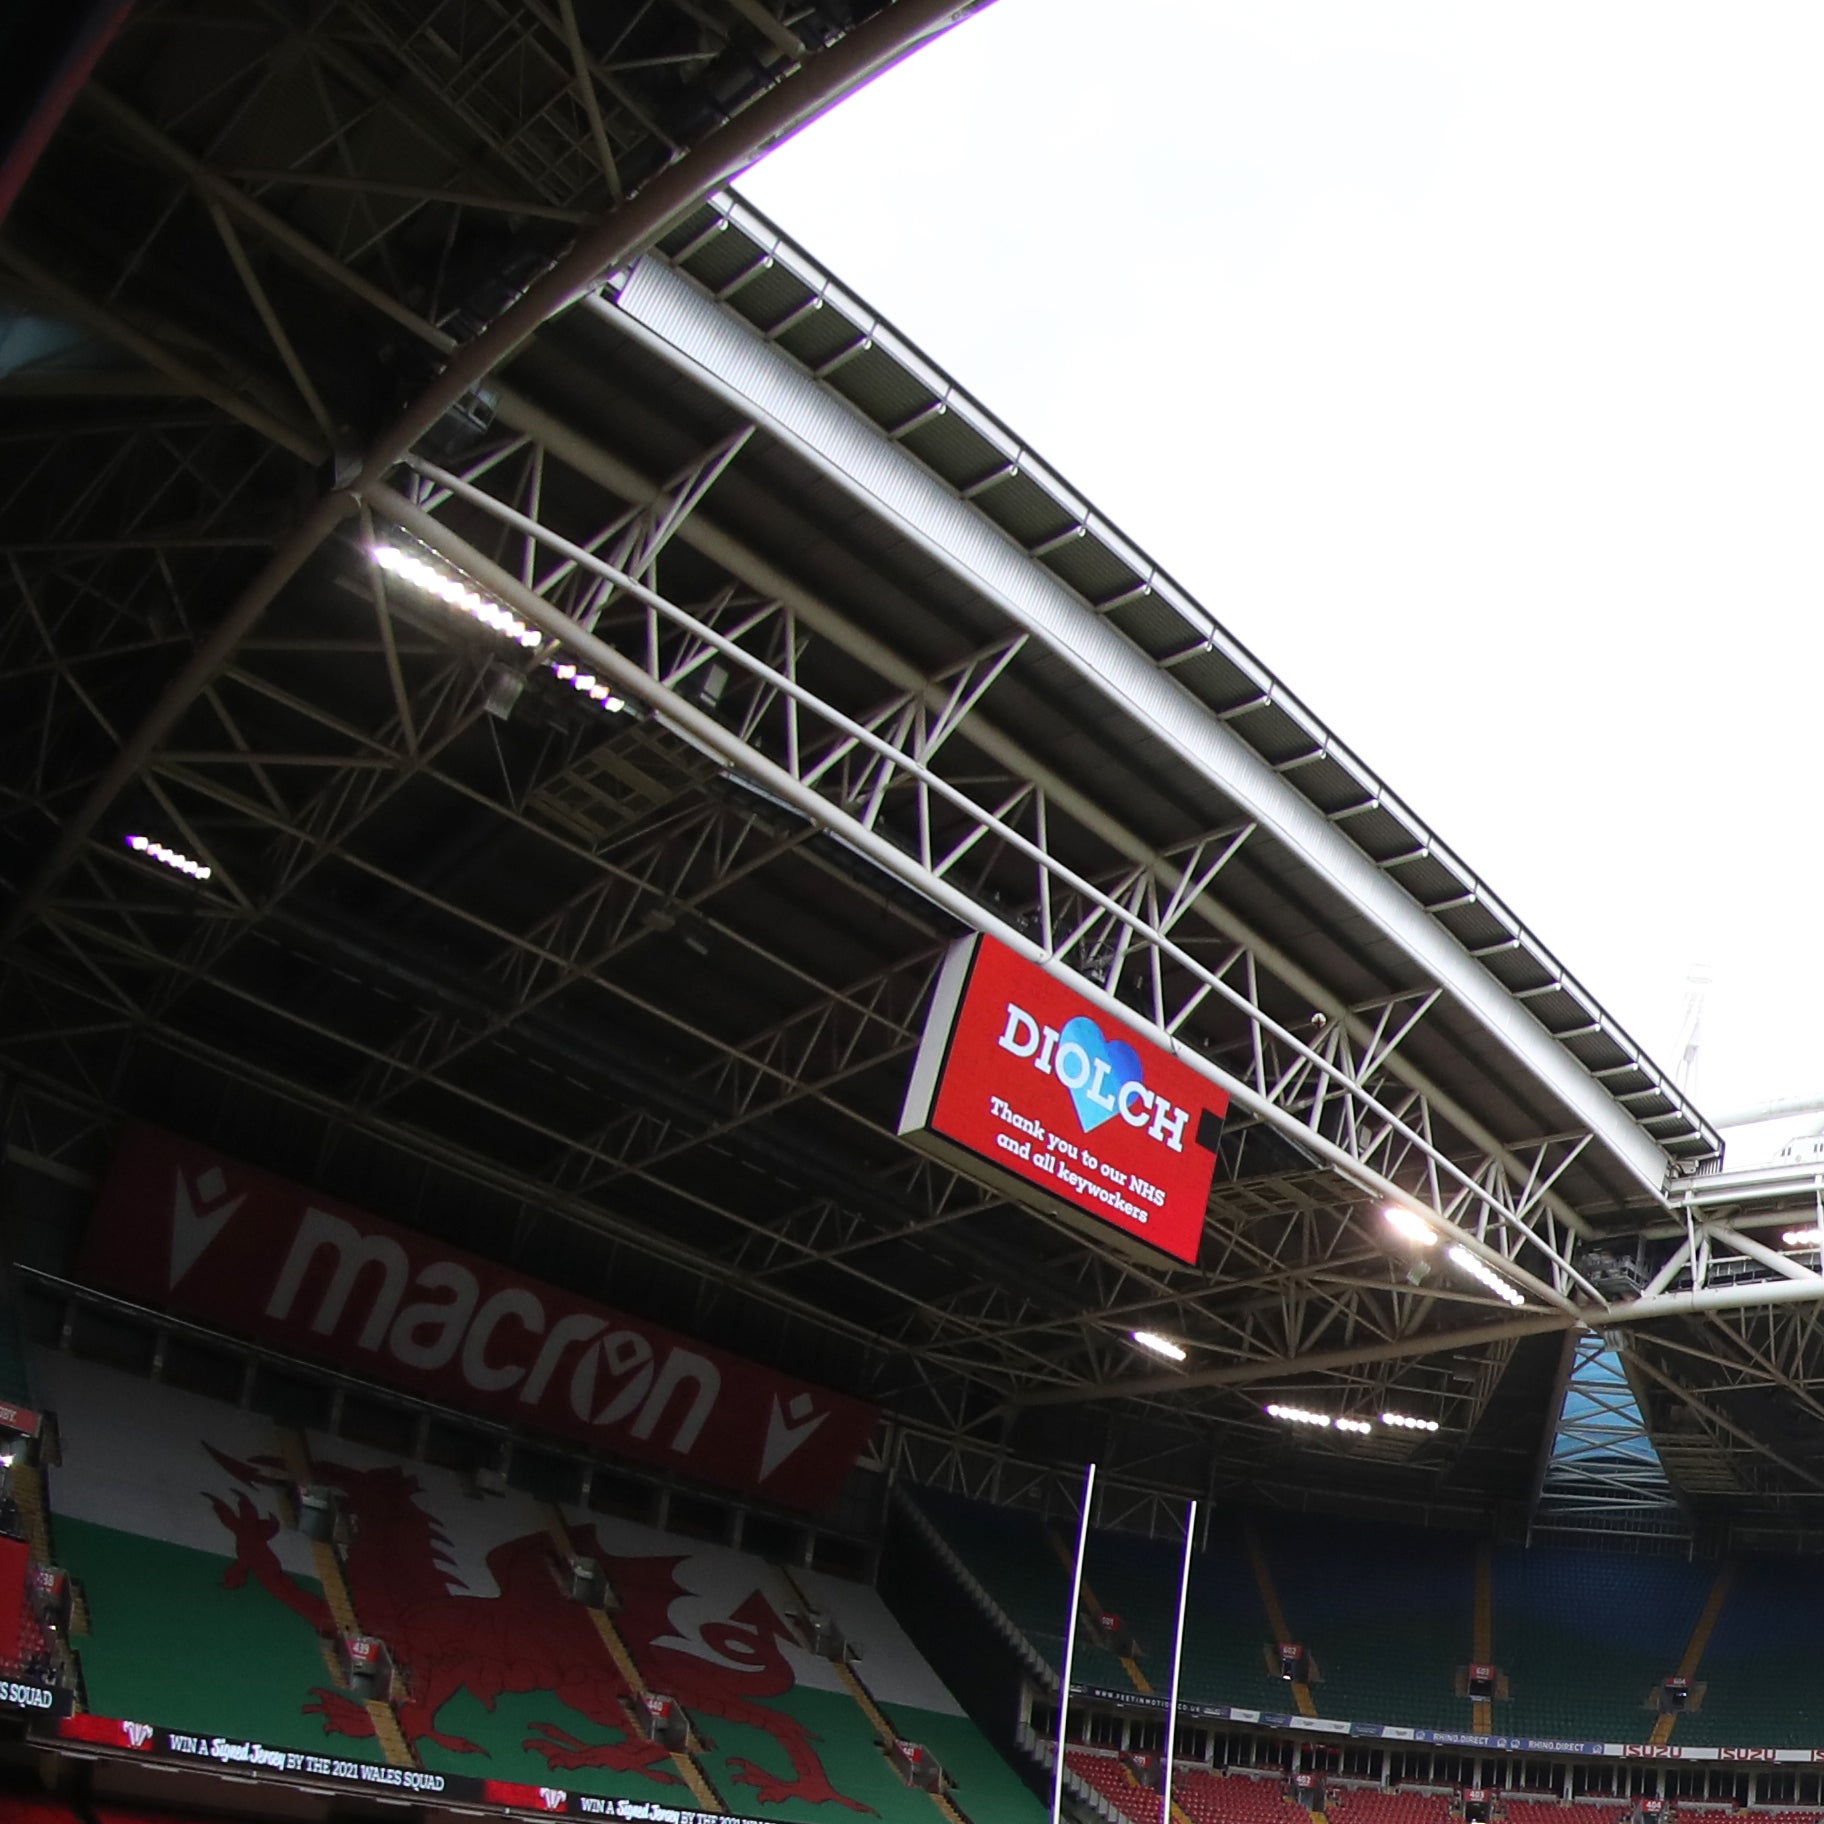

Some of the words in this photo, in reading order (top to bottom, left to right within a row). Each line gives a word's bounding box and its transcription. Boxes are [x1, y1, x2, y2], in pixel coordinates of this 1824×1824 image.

[998, 1003, 1190, 1153] DIOLCH
[990, 1096, 1045, 1142] Thank
[1047, 1129, 1079, 1160] you
[1082, 1149, 1098, 1171] to
[1100, 1161, 1127, 1186] our
[1128, 1172, 1166, 1207] NHS
[997, 1134, 1030, 1161] and
[1033, 1148, 1056, 1175] all
[1057, 1161, 1149, 1224] keyworkers
[266, 1206, 721, 1453] macron
[353, 1642, 370, 1654] 439
[9, 1683, 52, 1709] SQUAD
[1433, 1733, 1490, 1745] RHINO.DIRECT
[1528, 1740, 1585, 1752] RHINO.DIRECT
[1623, 1745, 1683, 1758] ISUZU
[1719, 1748, 1776, 1761] ISUZU
[170, 1734, 195, 1753] WIN
[198, 1740, 208, 1755] A
[211, 1739, 248, 1762] Signed
[249, 1744, 285, 1770] Jersey
[287, 1753, 303, 1770] BY
[306, 1756, 330, 1774] THE
[332, 1761, 358, 1779] 2021
[361, 1765, 401, 1785] WALES
[403, 1772, 444, 1791] SQUAD
[1646, 1801, 1661, 1809] 404
